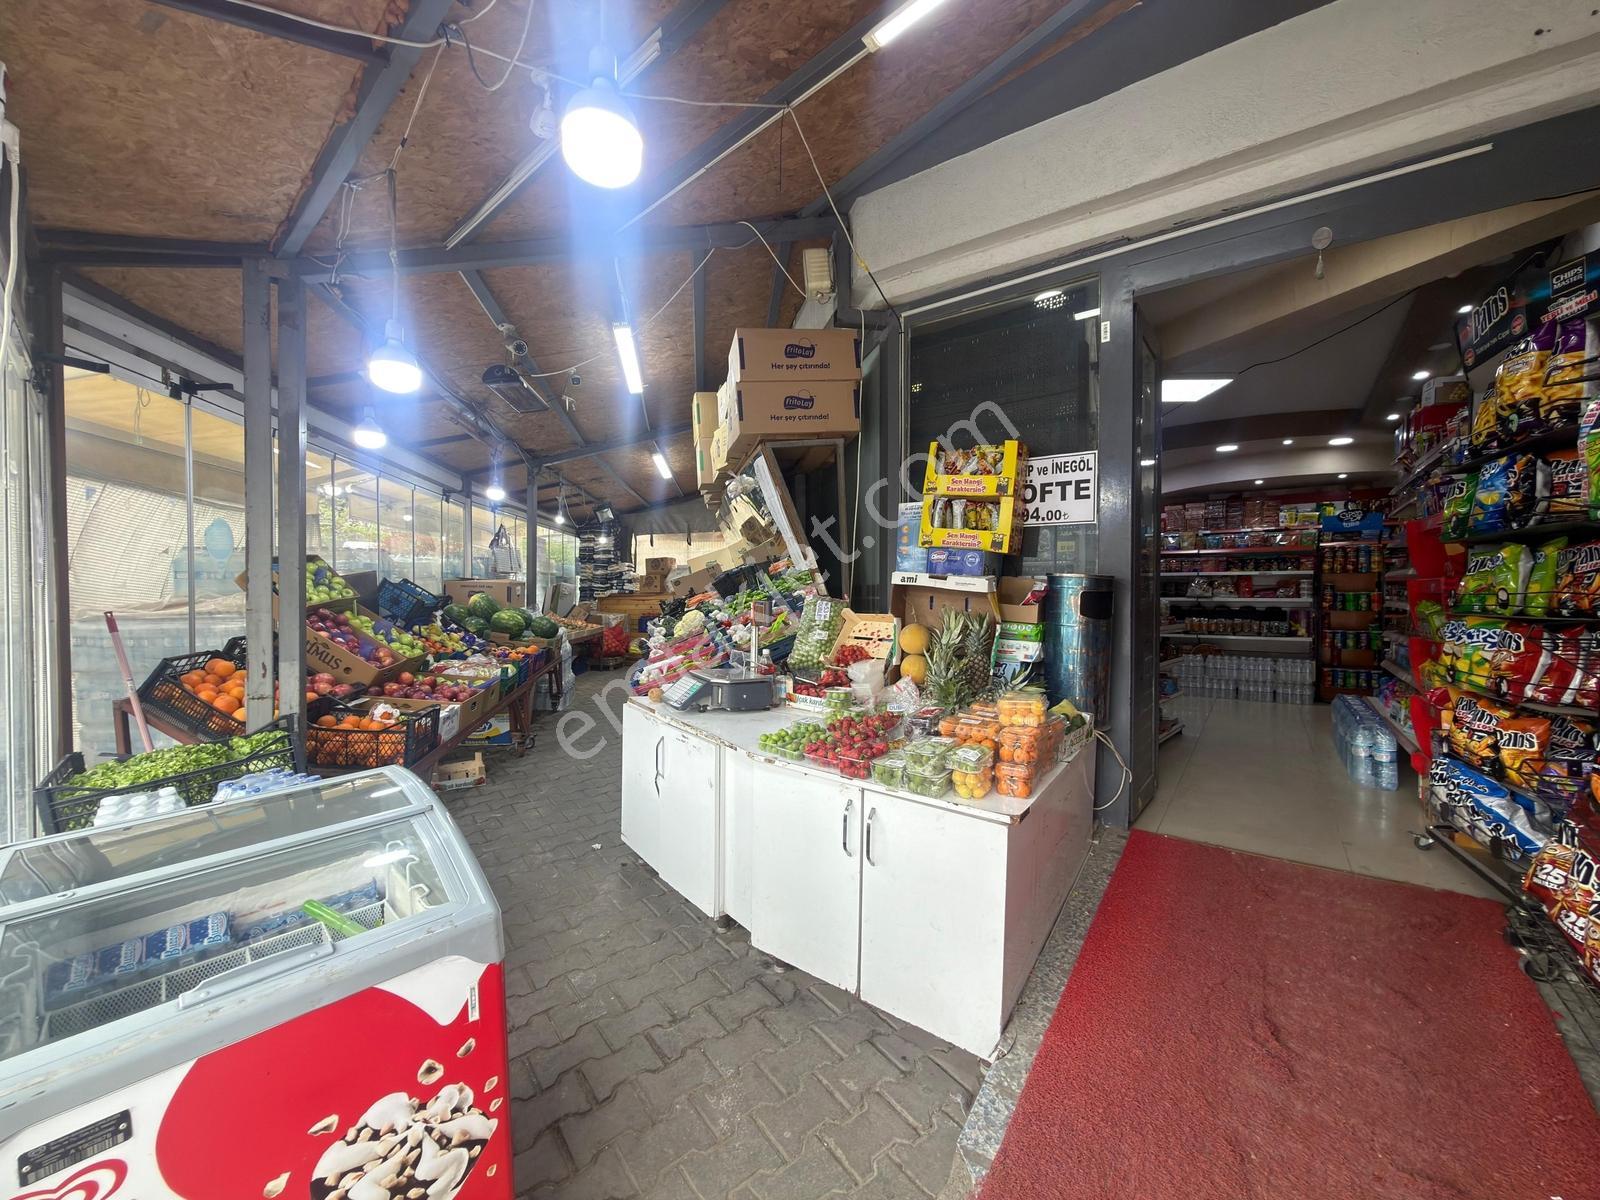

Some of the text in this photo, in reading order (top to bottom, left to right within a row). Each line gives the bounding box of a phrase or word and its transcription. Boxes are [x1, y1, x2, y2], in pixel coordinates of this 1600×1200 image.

[1552, 266, 1583, 284] CHIPS
[1553, 273, 1583, 290] MASTER
[785, 363, 797, 371] şey
[1037, 466, 1048, 476] ve
[1051, 456, 1092, 475] İNEGÖL
[951, 478, 983, 487] Sen Hangi
[946, 485, 986, 493] Karaktersin?
[1022, 479, 1091, 504] ÖFTE
[959, 532, 978, 540] Hangi
[941, 539, 982, 547] Karaktersin?
